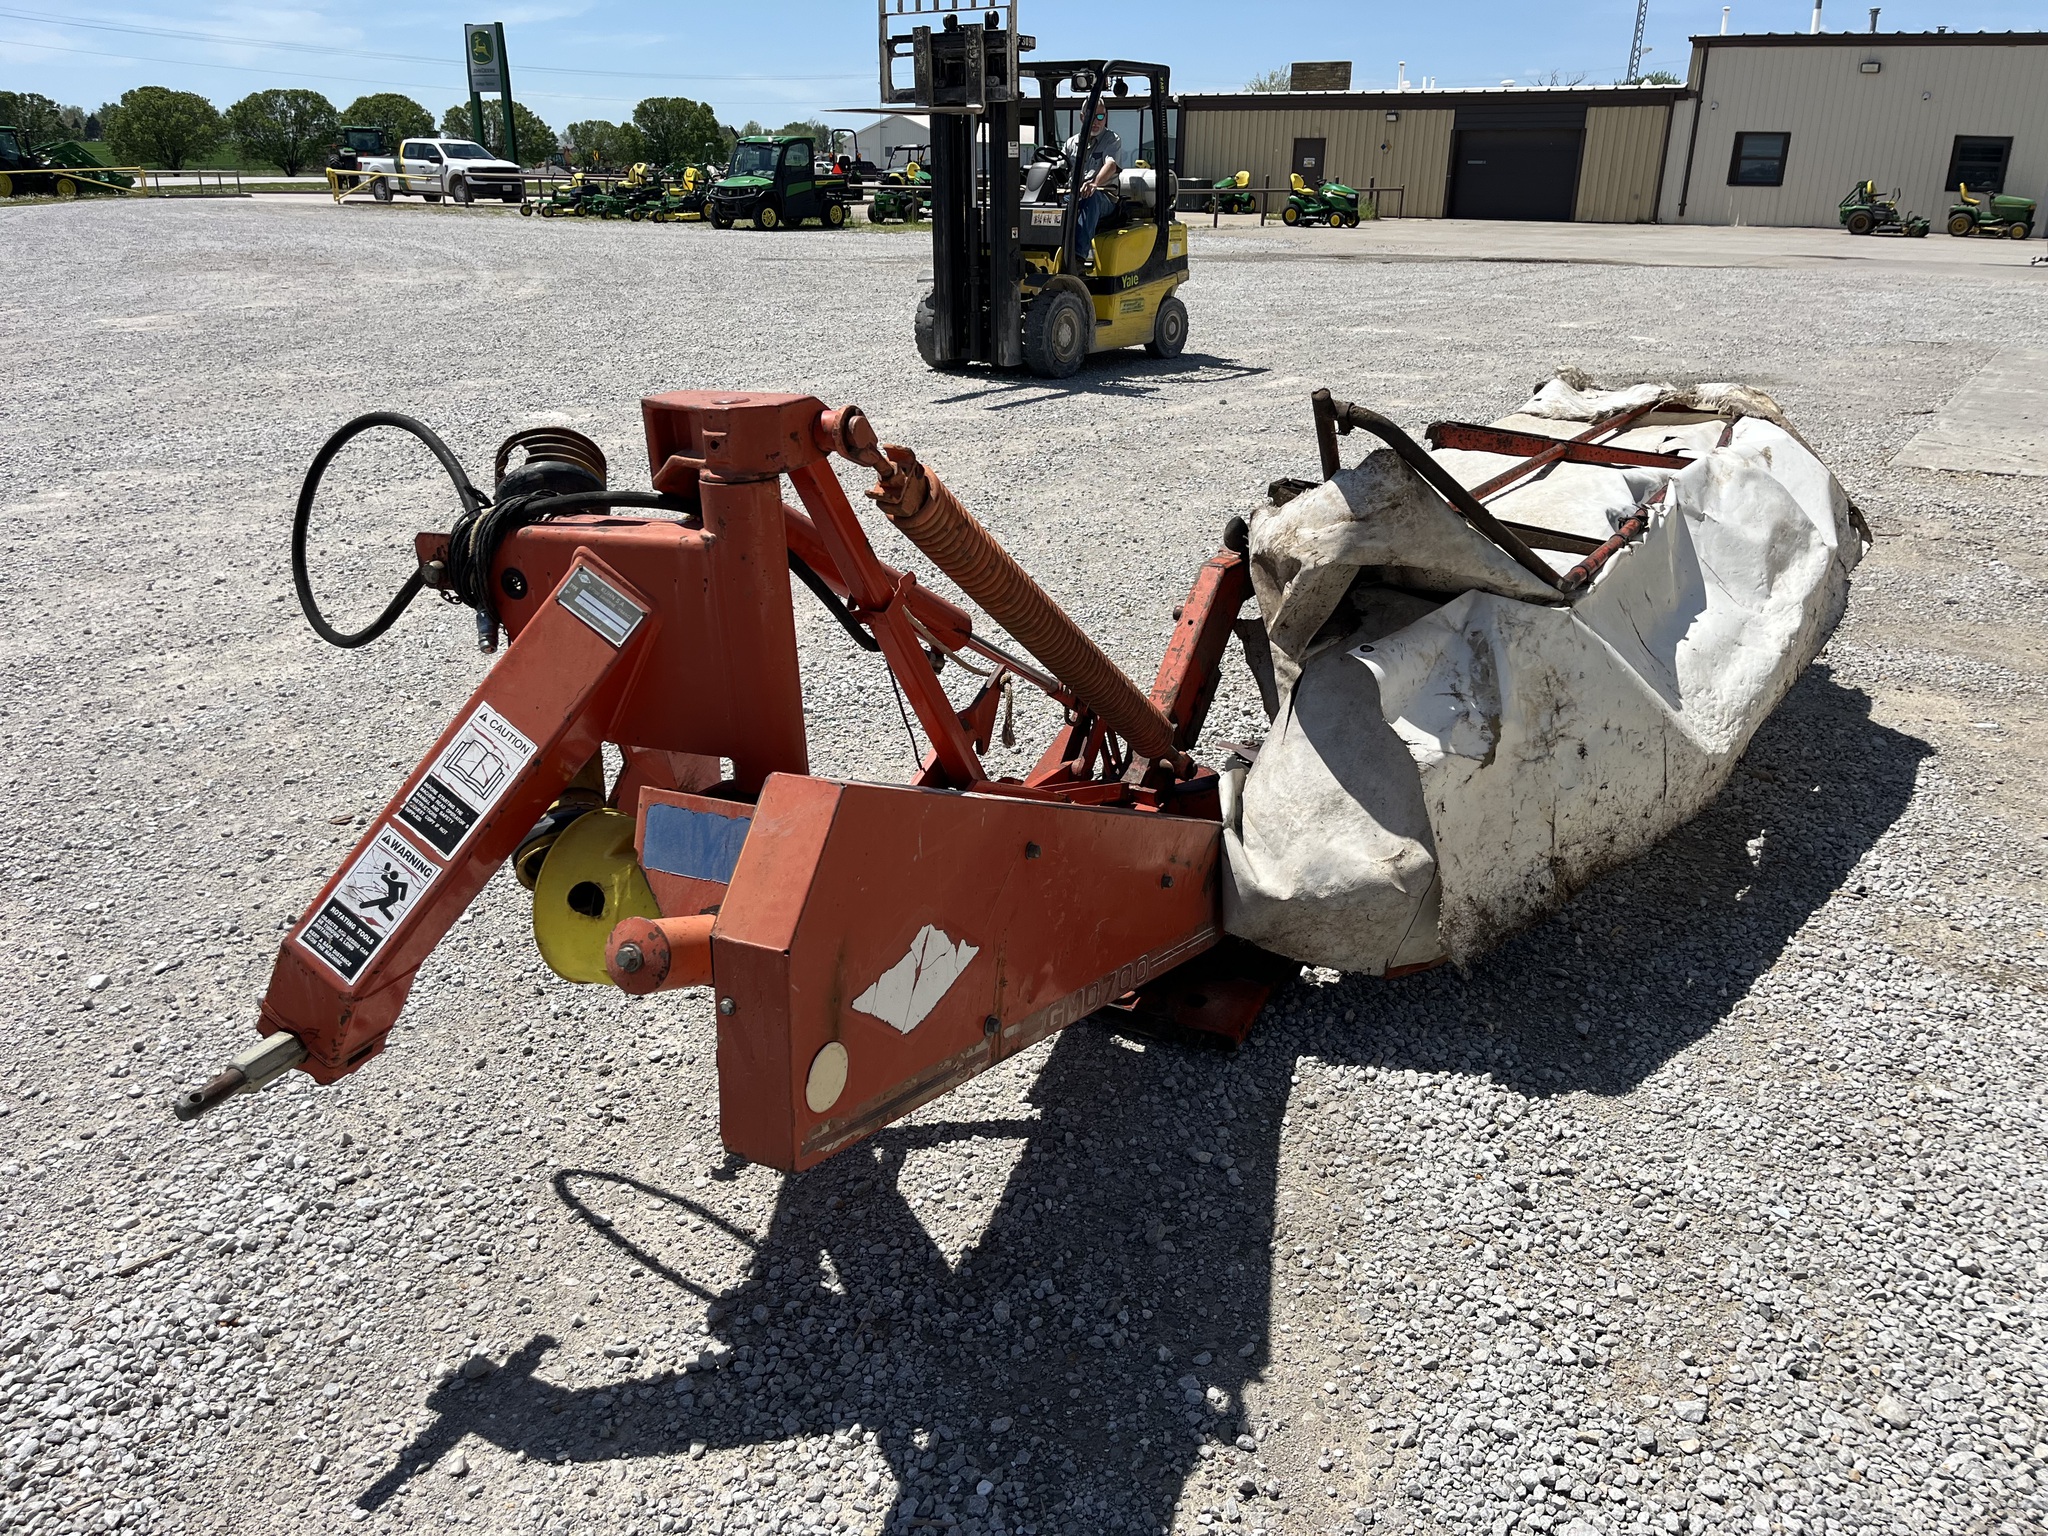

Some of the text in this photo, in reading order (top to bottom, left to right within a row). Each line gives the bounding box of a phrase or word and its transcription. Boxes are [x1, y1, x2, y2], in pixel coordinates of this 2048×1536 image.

[1121, 274, 1139, 289] Yale
[600, 587, 616, 600] KUHN
[488, 718, 531, 755] CAUTION
[420, 787, 436, 801] MACHINE
[435, 800, 446, 810] READ
[423, 782, 464, 816] BEFORE STARTING THE
[431, 804, 440, 812] AND
[439, 811, 454, 825] SAFETY
[408, 802, 425, 816] QUEST
[424, 815, 436, 825] COPY
[439, 827, 448, 835] NOT
[389, 839, 434, 879] WARNING
[321, 914, 369, 956] OBJECTS AND DEBRIS CAN
[323, 924, 340, 939] THROWN
[343, 940, 355, 951] LONG
[330, 906, 375, 945] ROTATING TOOLS
[306, 934, 317, 944] FROM
[316, 943, 325, 951] THE
[309, 929, 320, 940] KEEP
[322, 941, 333, 951] SAFE
[332, 949, 352, 967] DISTANCE
